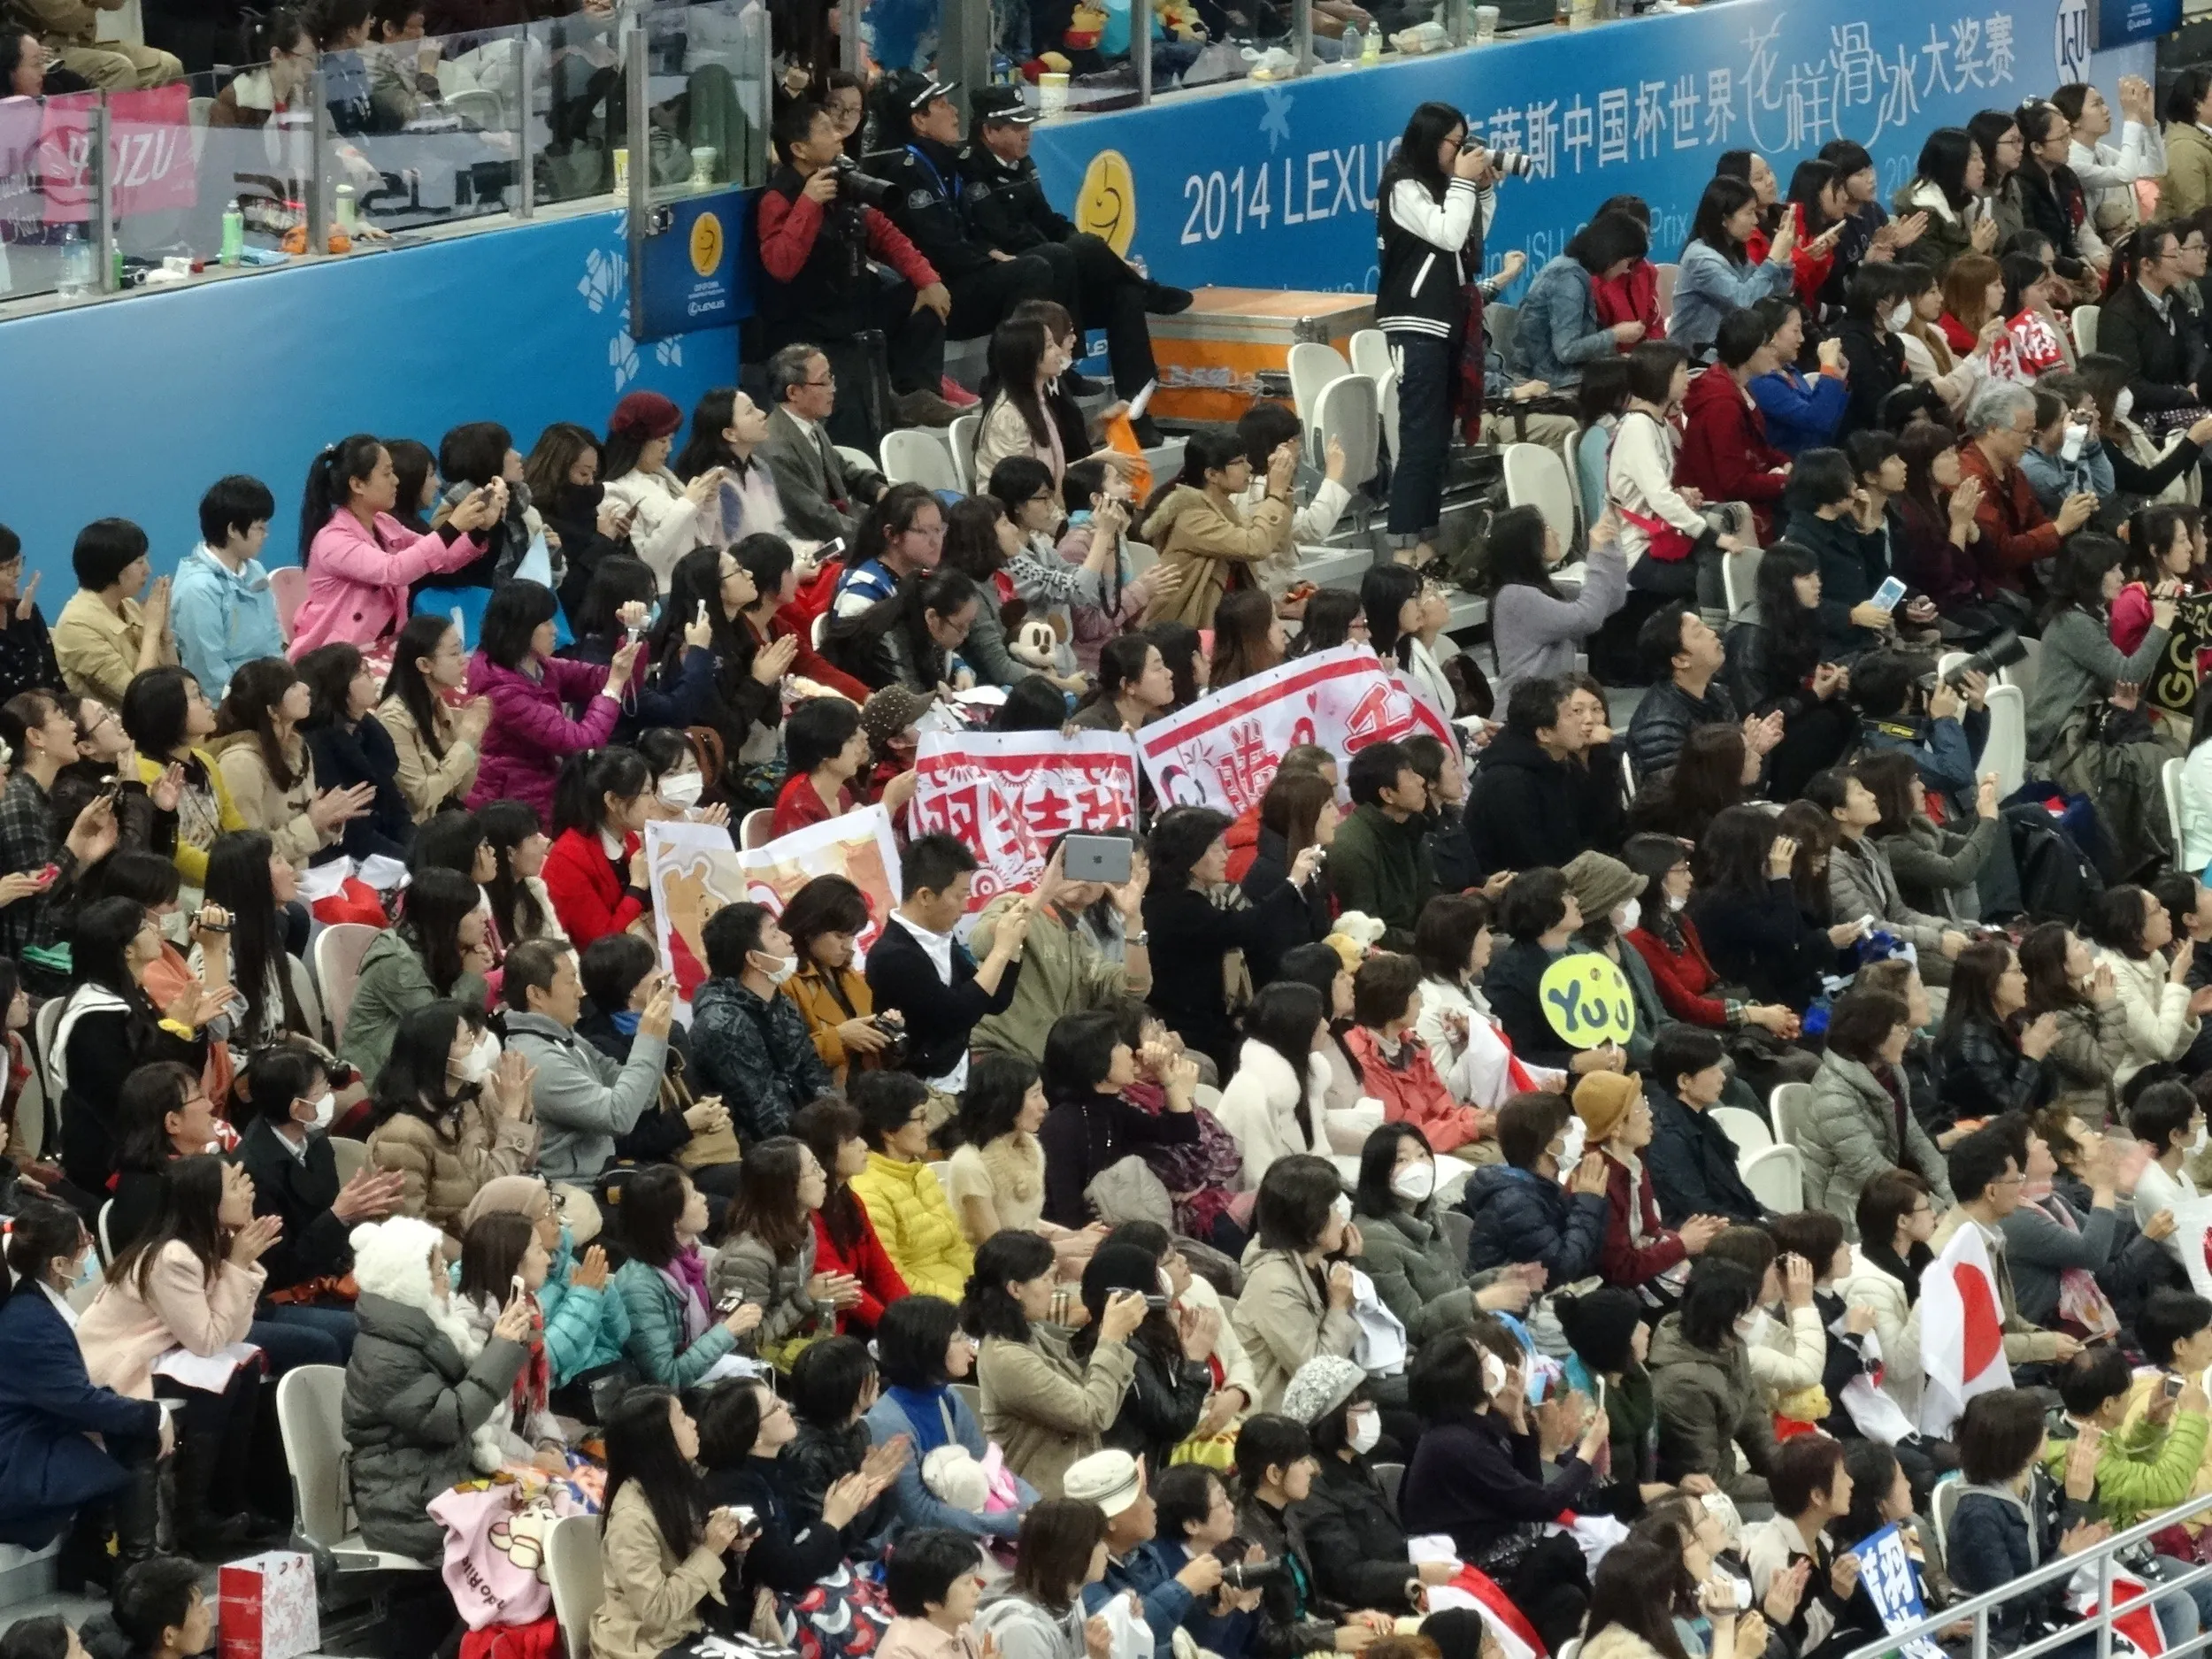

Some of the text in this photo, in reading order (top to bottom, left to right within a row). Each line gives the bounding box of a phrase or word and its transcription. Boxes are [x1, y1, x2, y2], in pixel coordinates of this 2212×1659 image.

[2059, 9, 2087, 83] ISU
[1466, 11, 2016, 188] 萨斯中国杯世界花样滑冰大奖赛
[1180, 134, 1403, 246] 2014 LEXU
[1649, 203, 1689, 252] Prix
